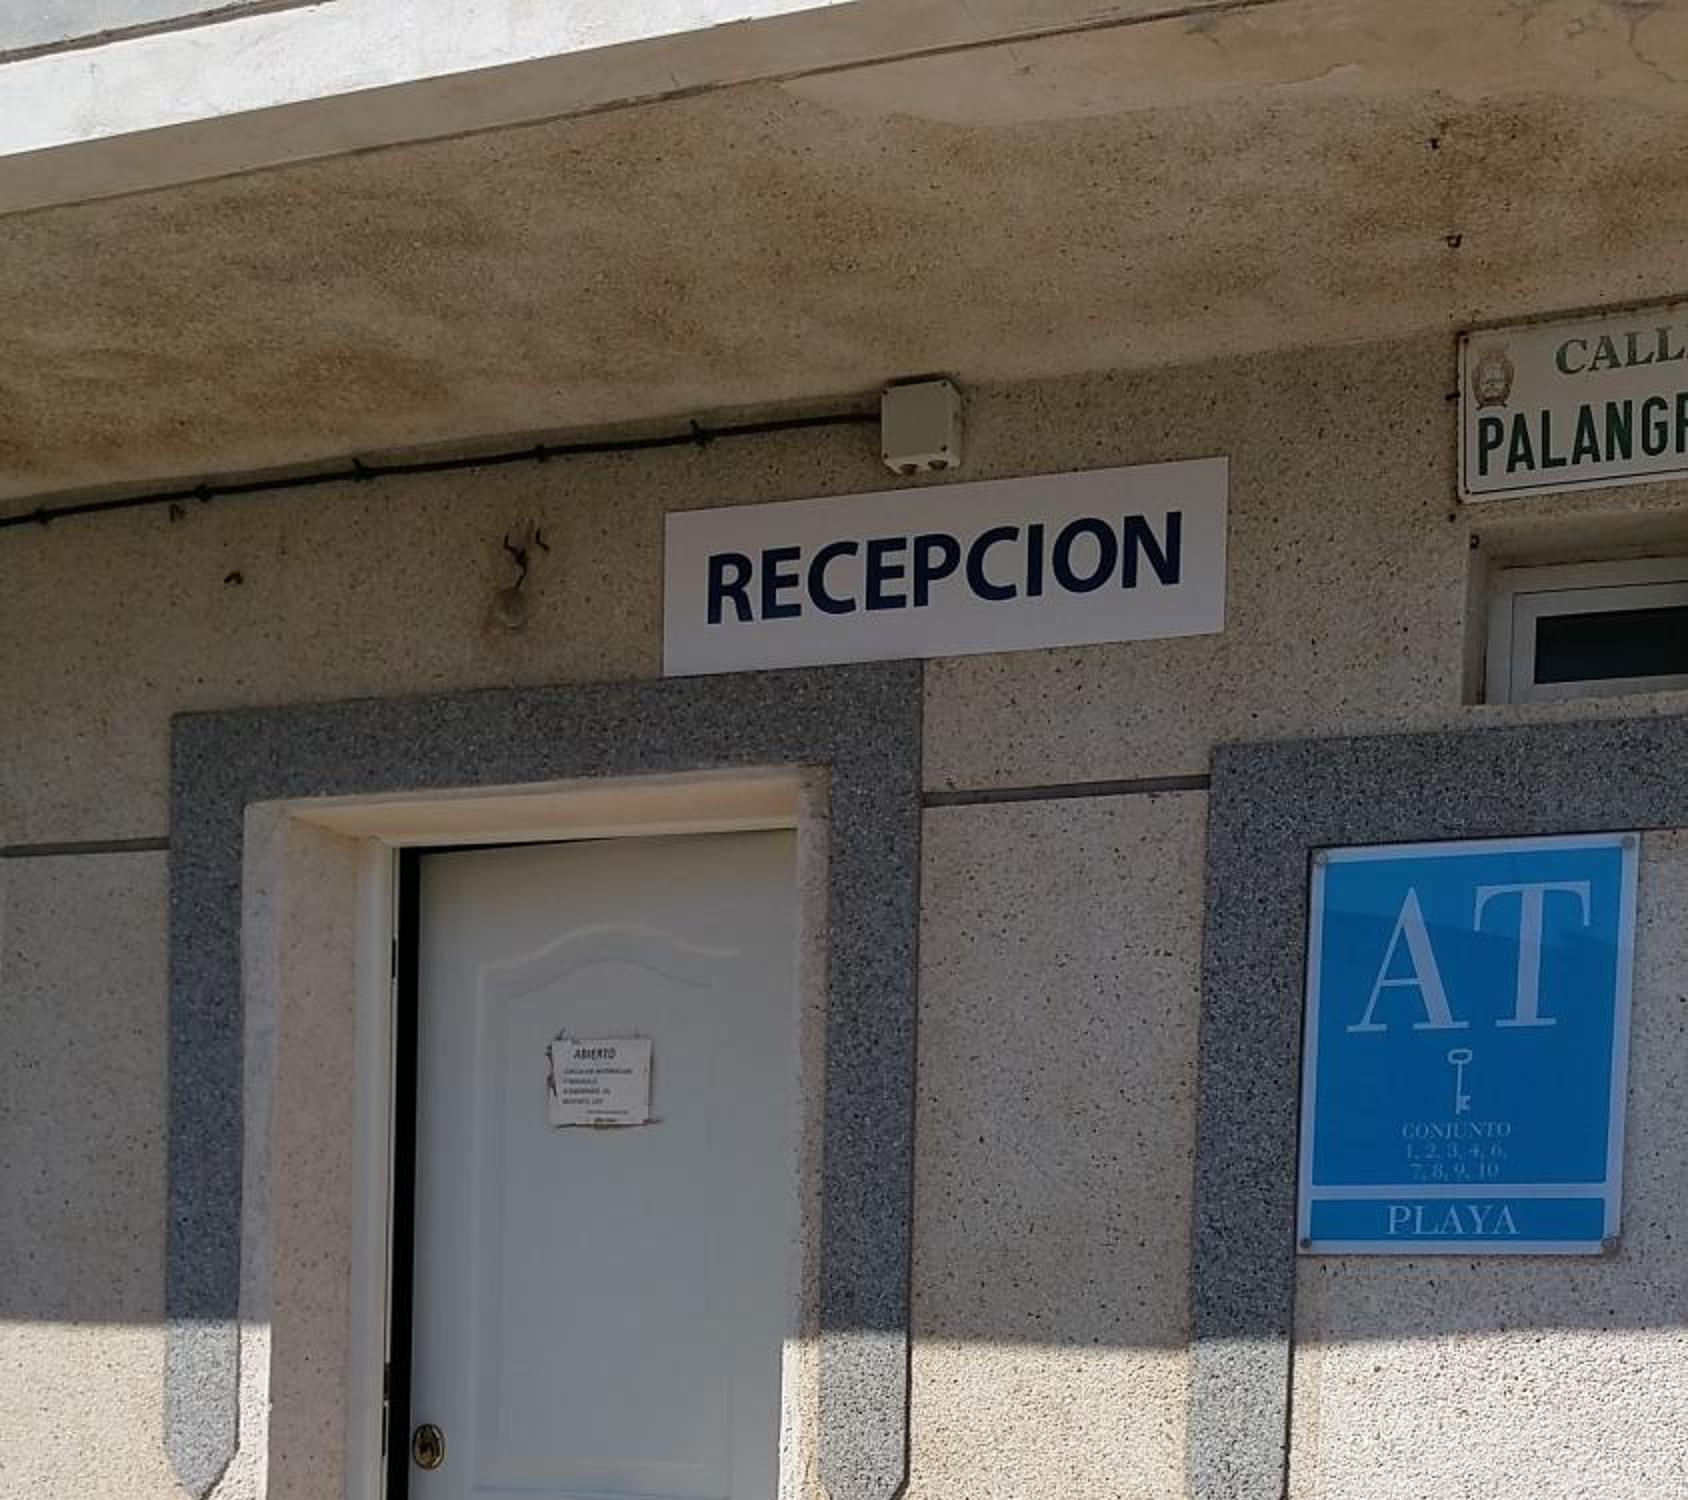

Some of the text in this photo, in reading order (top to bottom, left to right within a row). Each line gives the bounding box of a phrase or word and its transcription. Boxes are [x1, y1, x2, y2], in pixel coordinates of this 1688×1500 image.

[1555, 325, 1688, 375] CALL
[706, 511, 1183, 625] RECEPCION
[1346, 880, 1591, 1032] AT
[1402, 1120, 1511, 1139] CONJUNTO
[1479, 1161, 1499, 1179] 10
[1384, 1202, 1521, 1235] PLAYA
